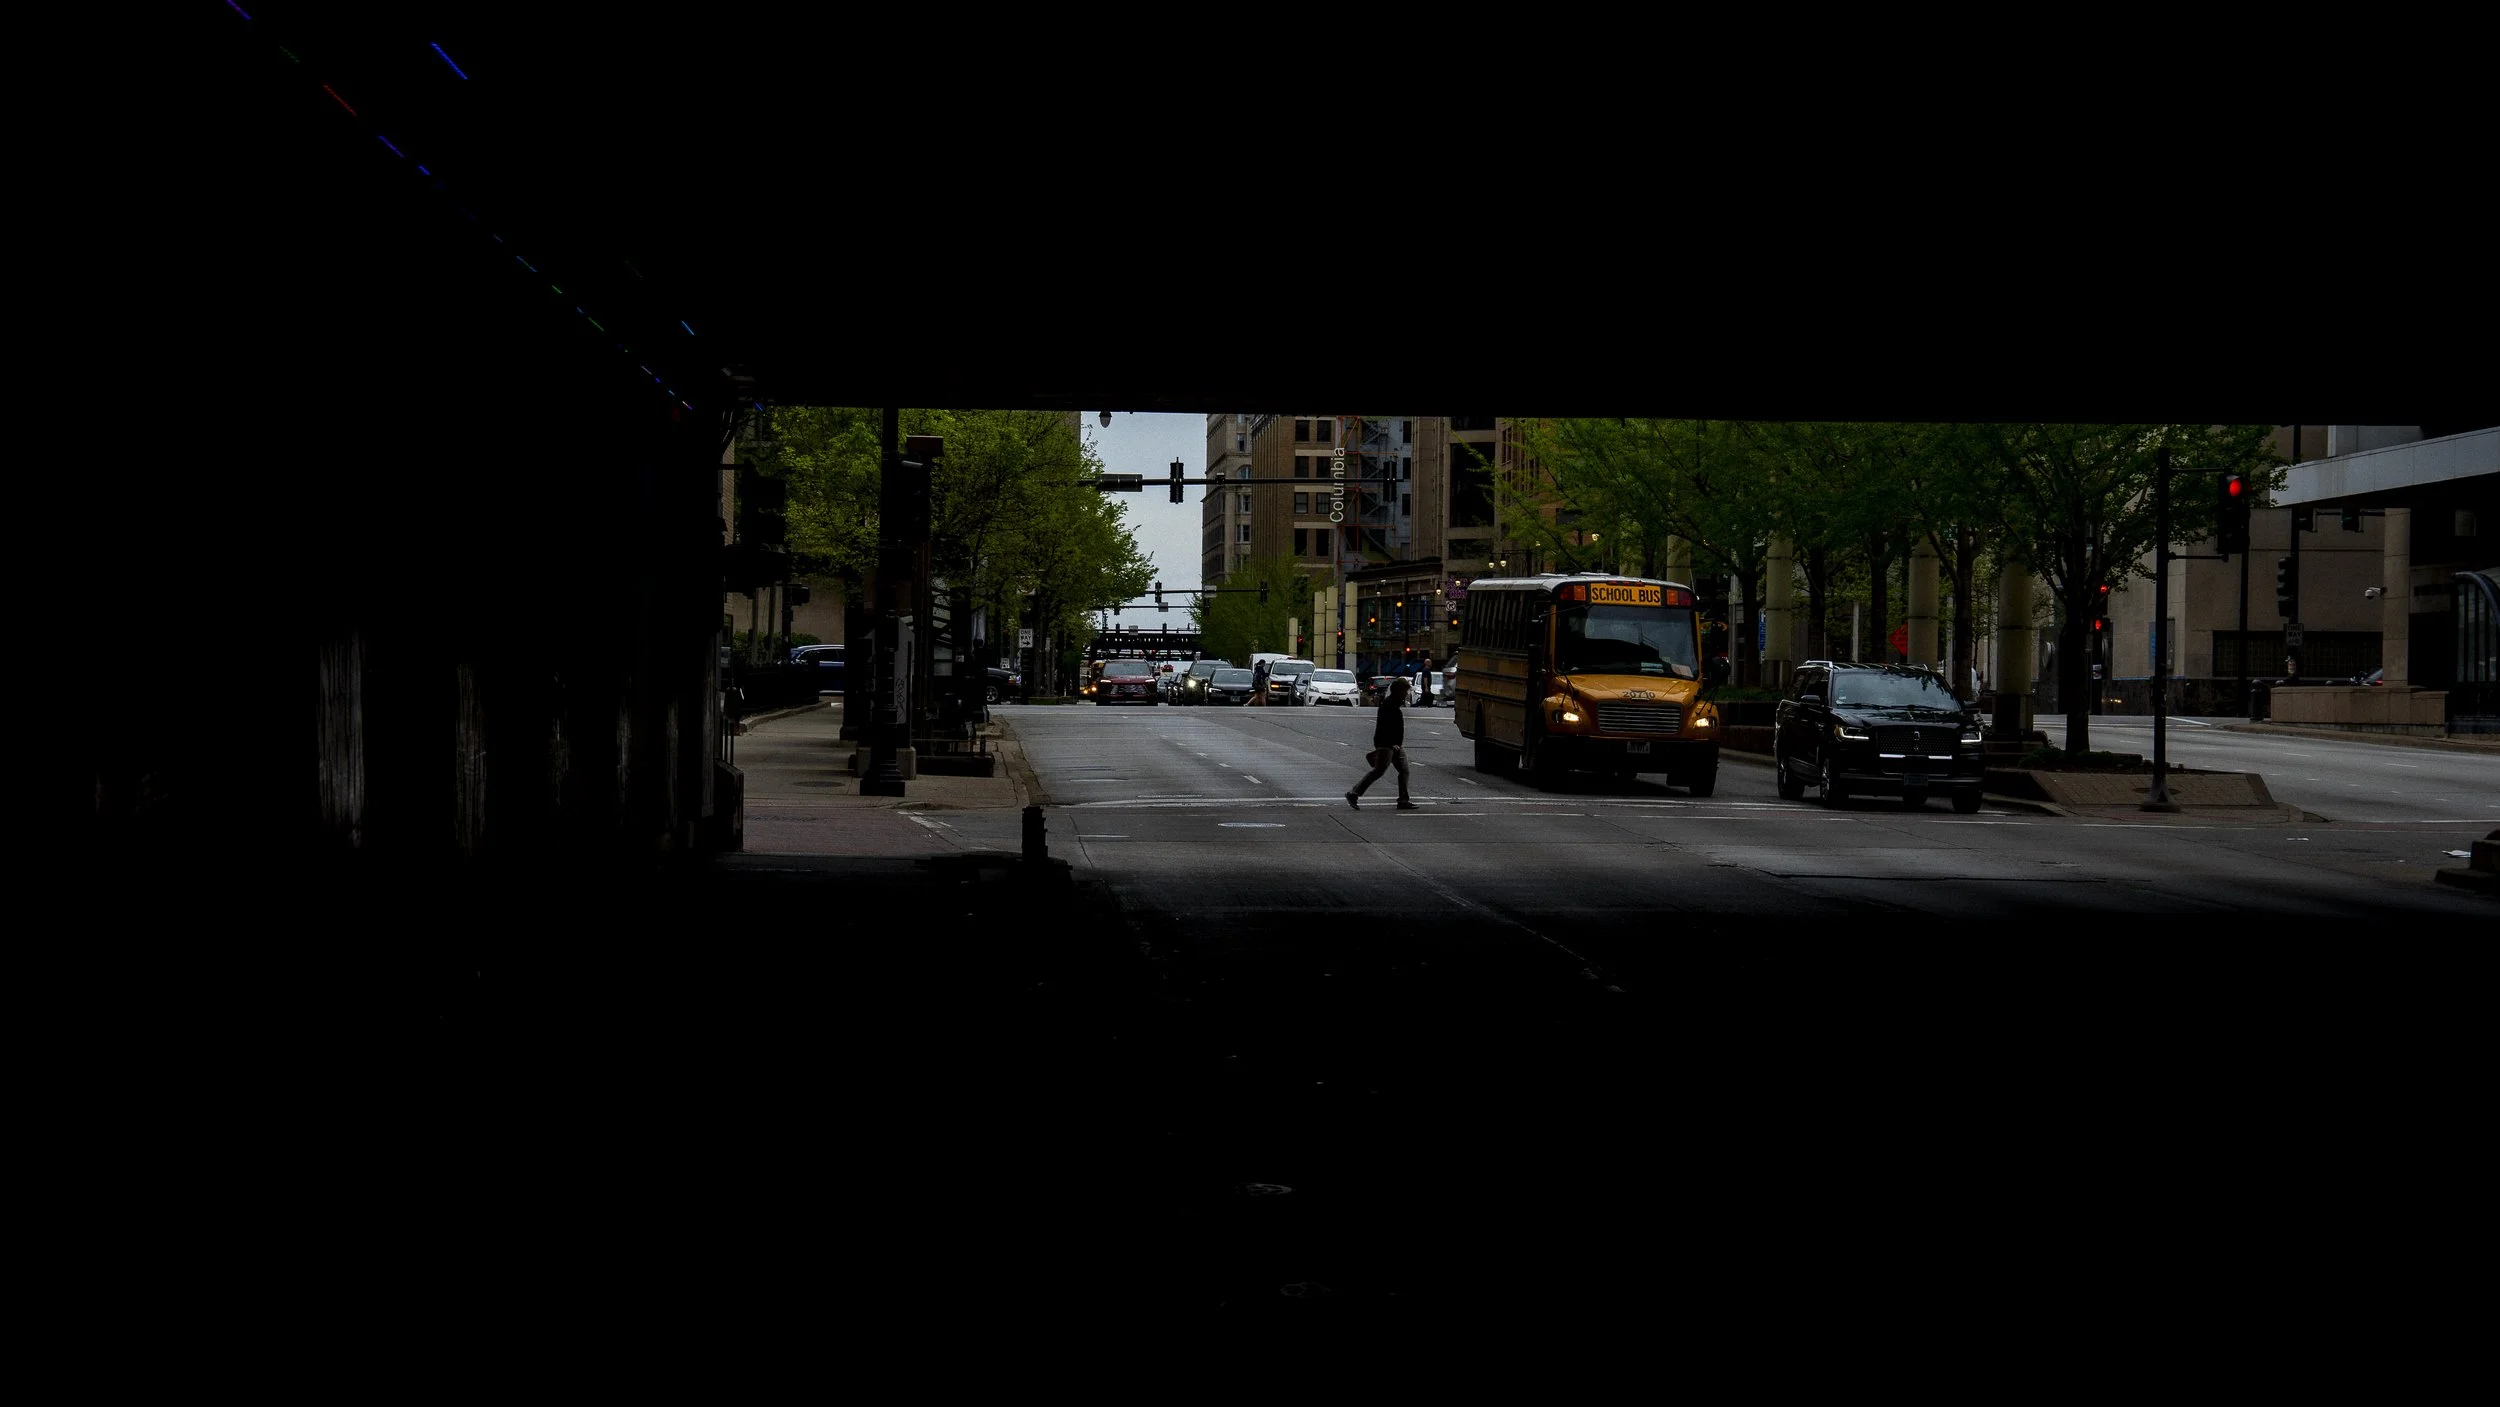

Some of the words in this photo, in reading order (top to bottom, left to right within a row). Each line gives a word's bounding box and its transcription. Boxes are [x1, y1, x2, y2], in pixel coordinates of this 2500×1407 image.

[1329, 447, 1345, 522] Columbia
[1592, 587, 1636, 602] SCHOOL
[1639, 589, 1660, 603] BUS
